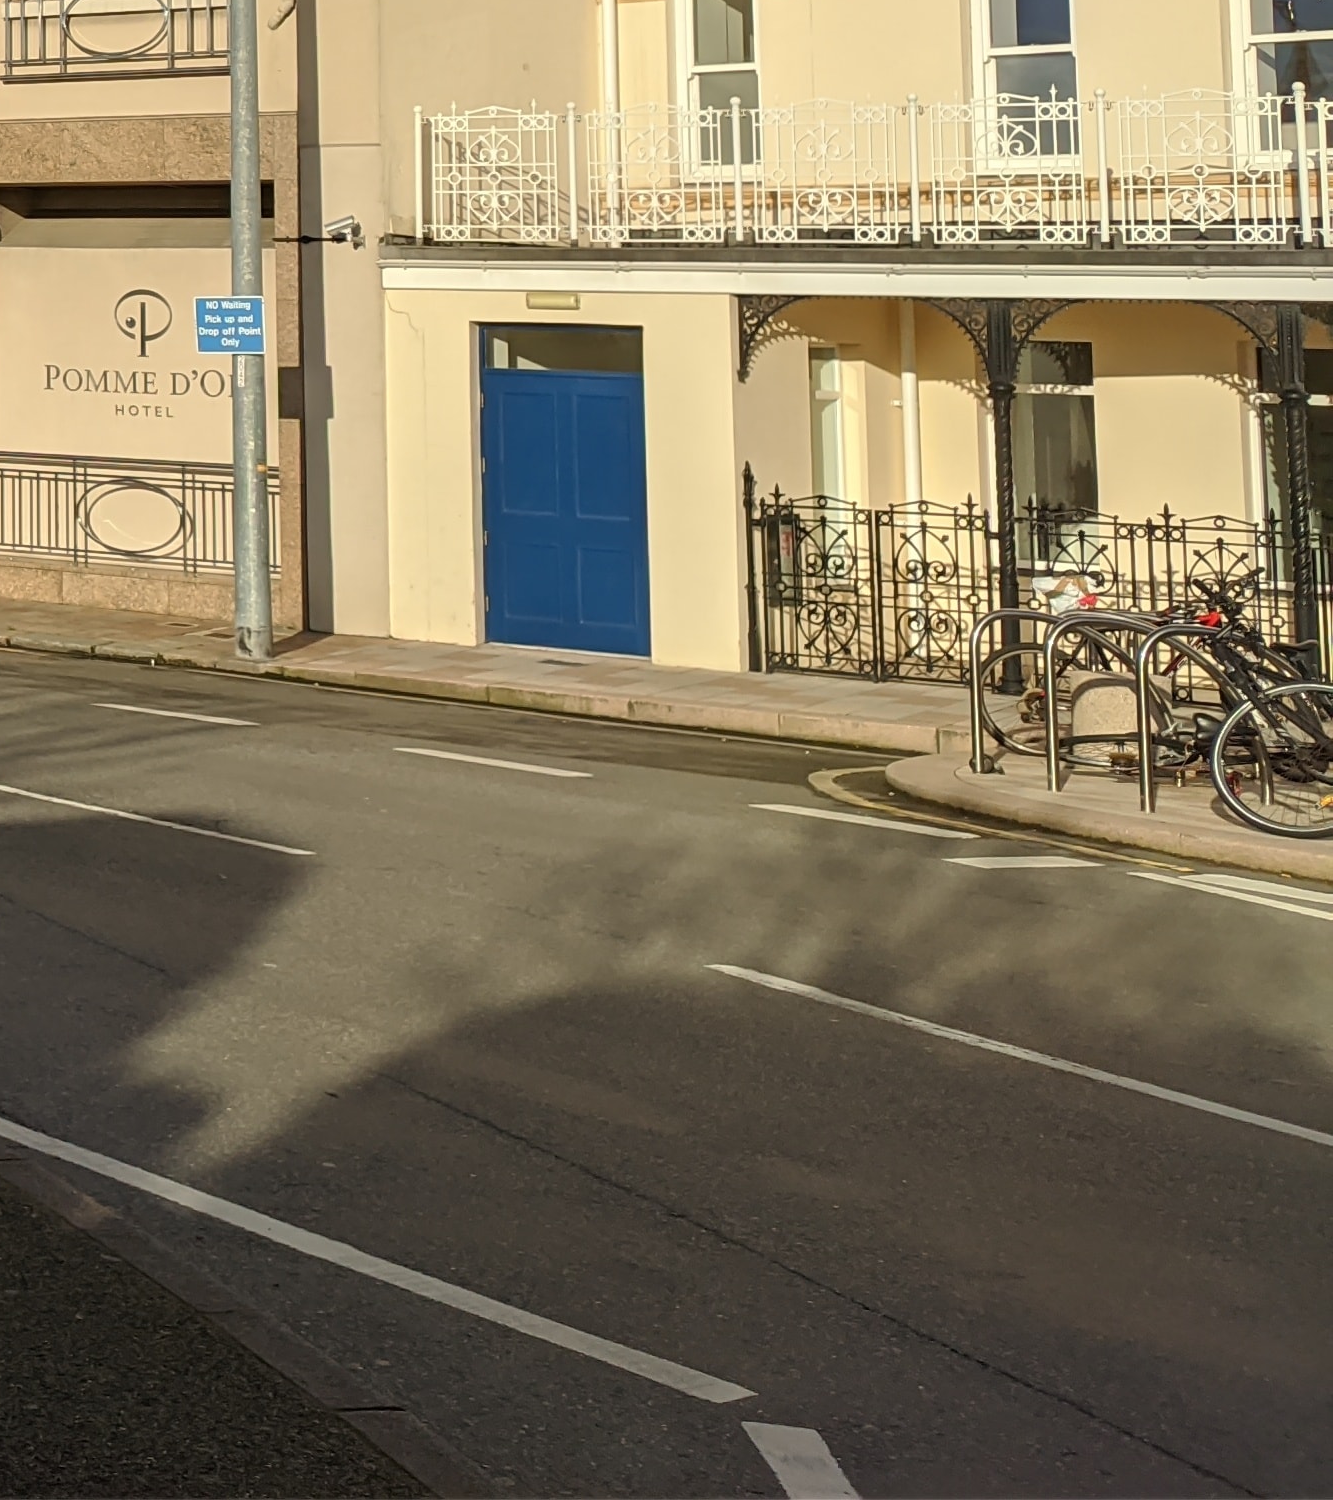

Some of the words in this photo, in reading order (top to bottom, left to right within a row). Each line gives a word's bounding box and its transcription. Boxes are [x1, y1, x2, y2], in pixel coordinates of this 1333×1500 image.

[205, 301, 219, 310] NO
[221, 301, 252, 311] Waiting
[204, 314, 222, 324] Pick
[224, 316, 235, 324] up
[237, 315, 254, 323] and
[198, 327, 219, 337] Drop
[222, 327, 236, 336] off
[238, 327, 262, 336] Point
[221, 338, 241, 348] Only
[43, 364, 159, 396] POMME
[169, 369, 233, 398] D'O
[115, 404, 174, 418] HOTEL
